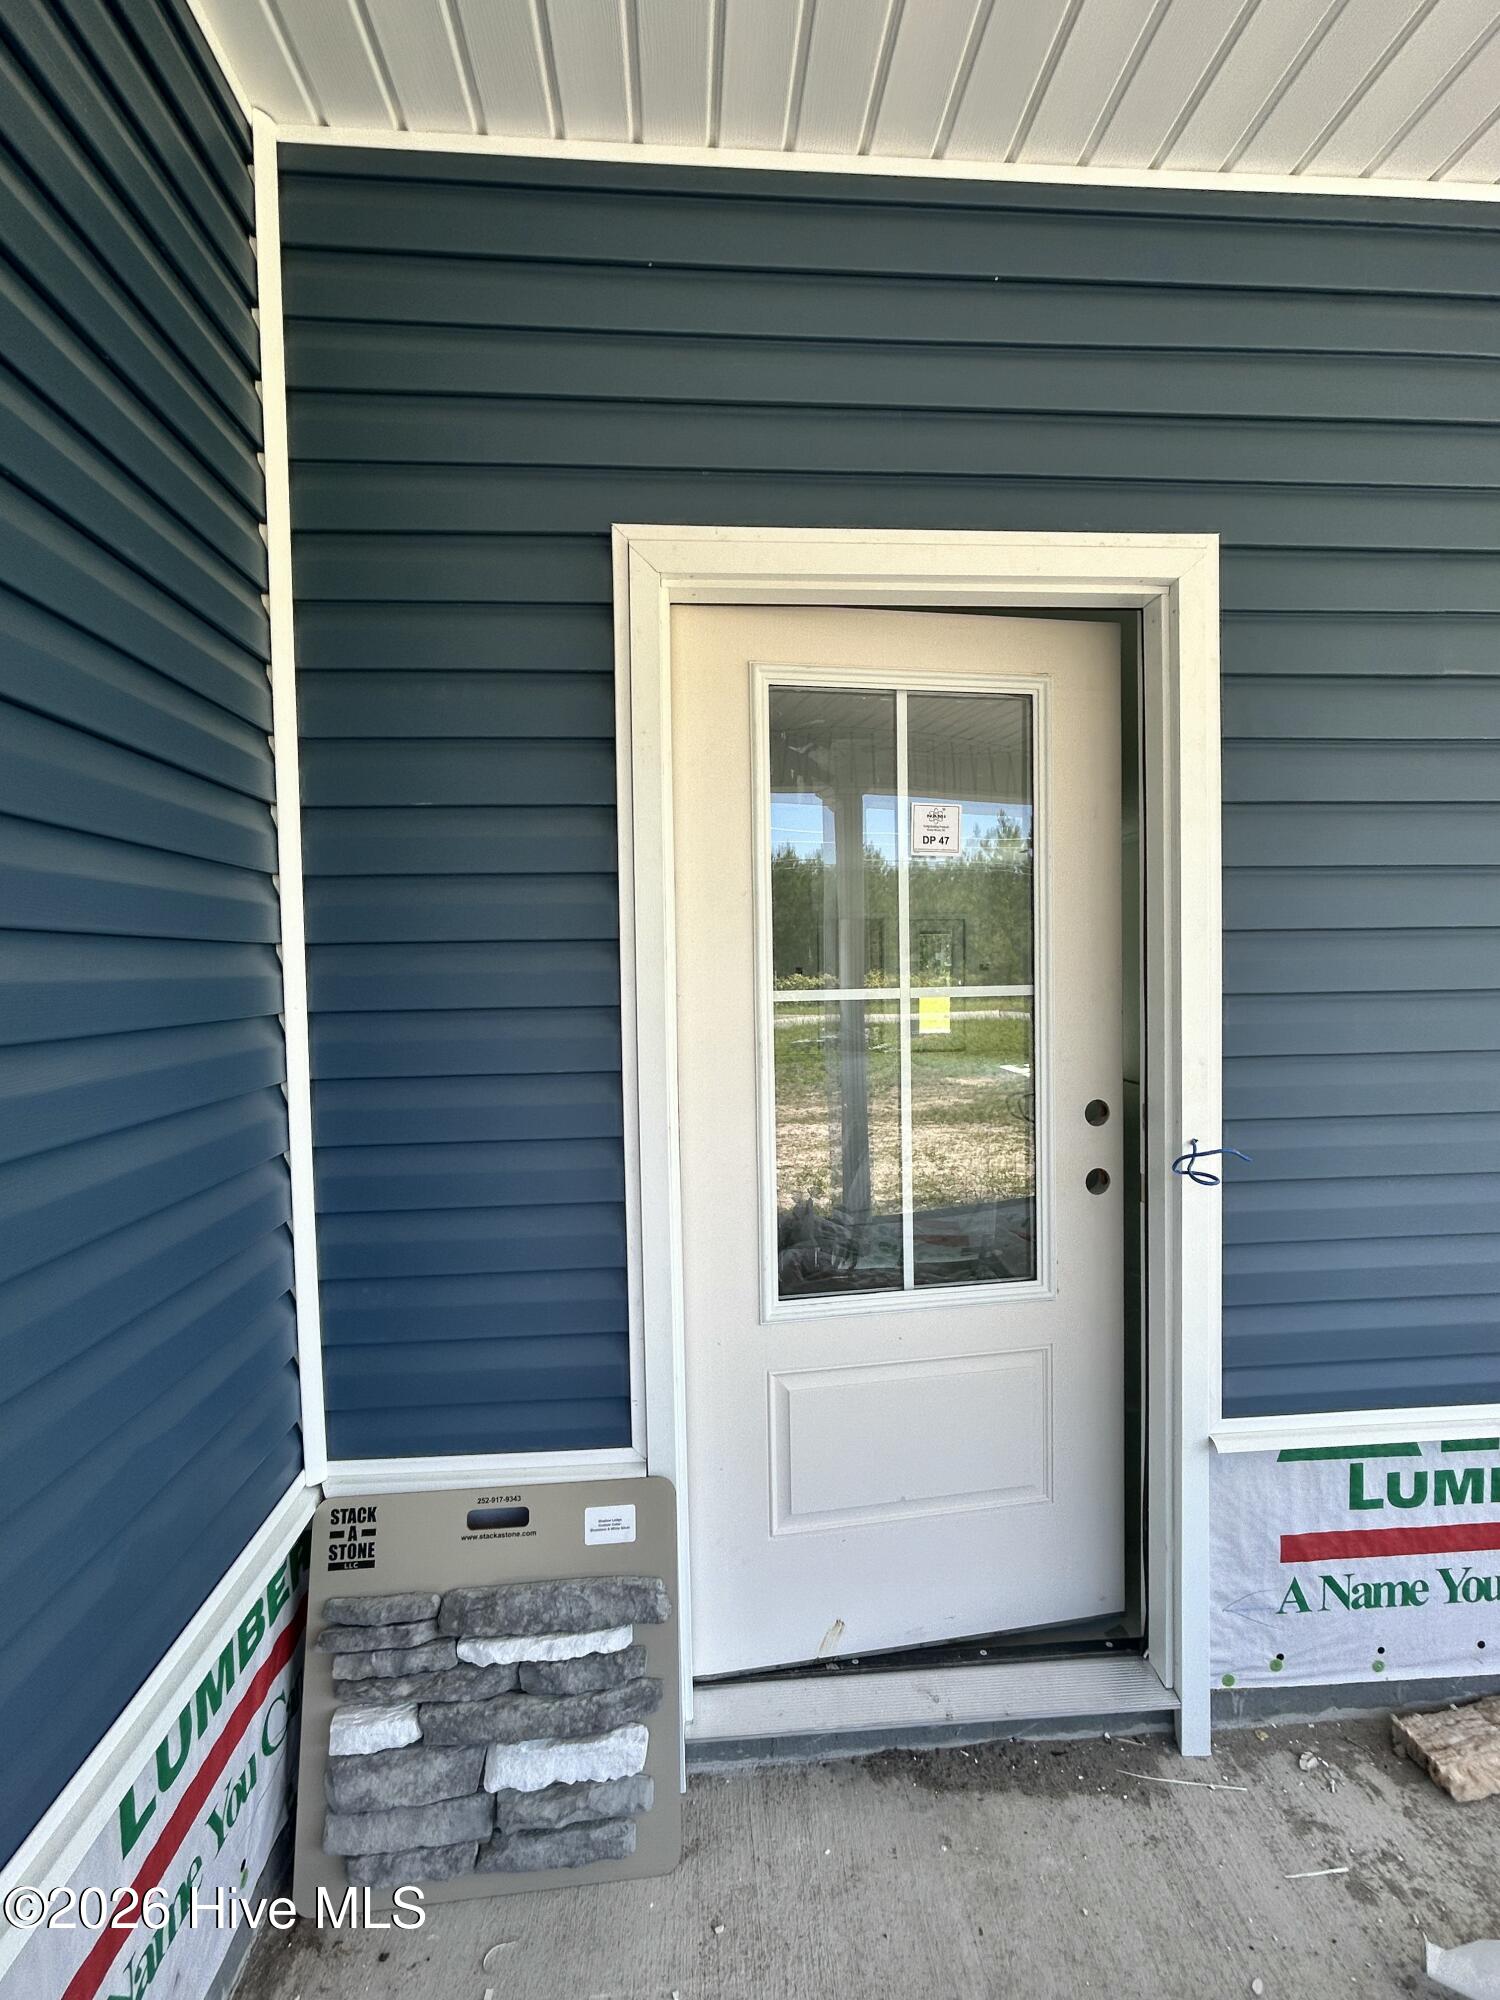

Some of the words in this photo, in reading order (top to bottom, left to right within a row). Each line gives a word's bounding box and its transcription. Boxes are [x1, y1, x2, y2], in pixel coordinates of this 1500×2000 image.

[922, 835, 936, 845] DP
[938, 836, 950, 845] 47
[1348, 1462, 1500, 1511] LUM
[477, 1495, 521, 1504] 252-917-9343
[330, 1506, 377, 1525] STACK
[461, 1530, 537, 1541] www.stackastone.com
[328, 1542, 375, 1561] STONE
[344, 1561, 359, 1569] LLC
[1276, 1575, 1312, 1615] A
[1317, 1573, 1430, 1611] Name
[1435, 1567, 1500, 1604] You
[205, 1750, 258, 1856] You
